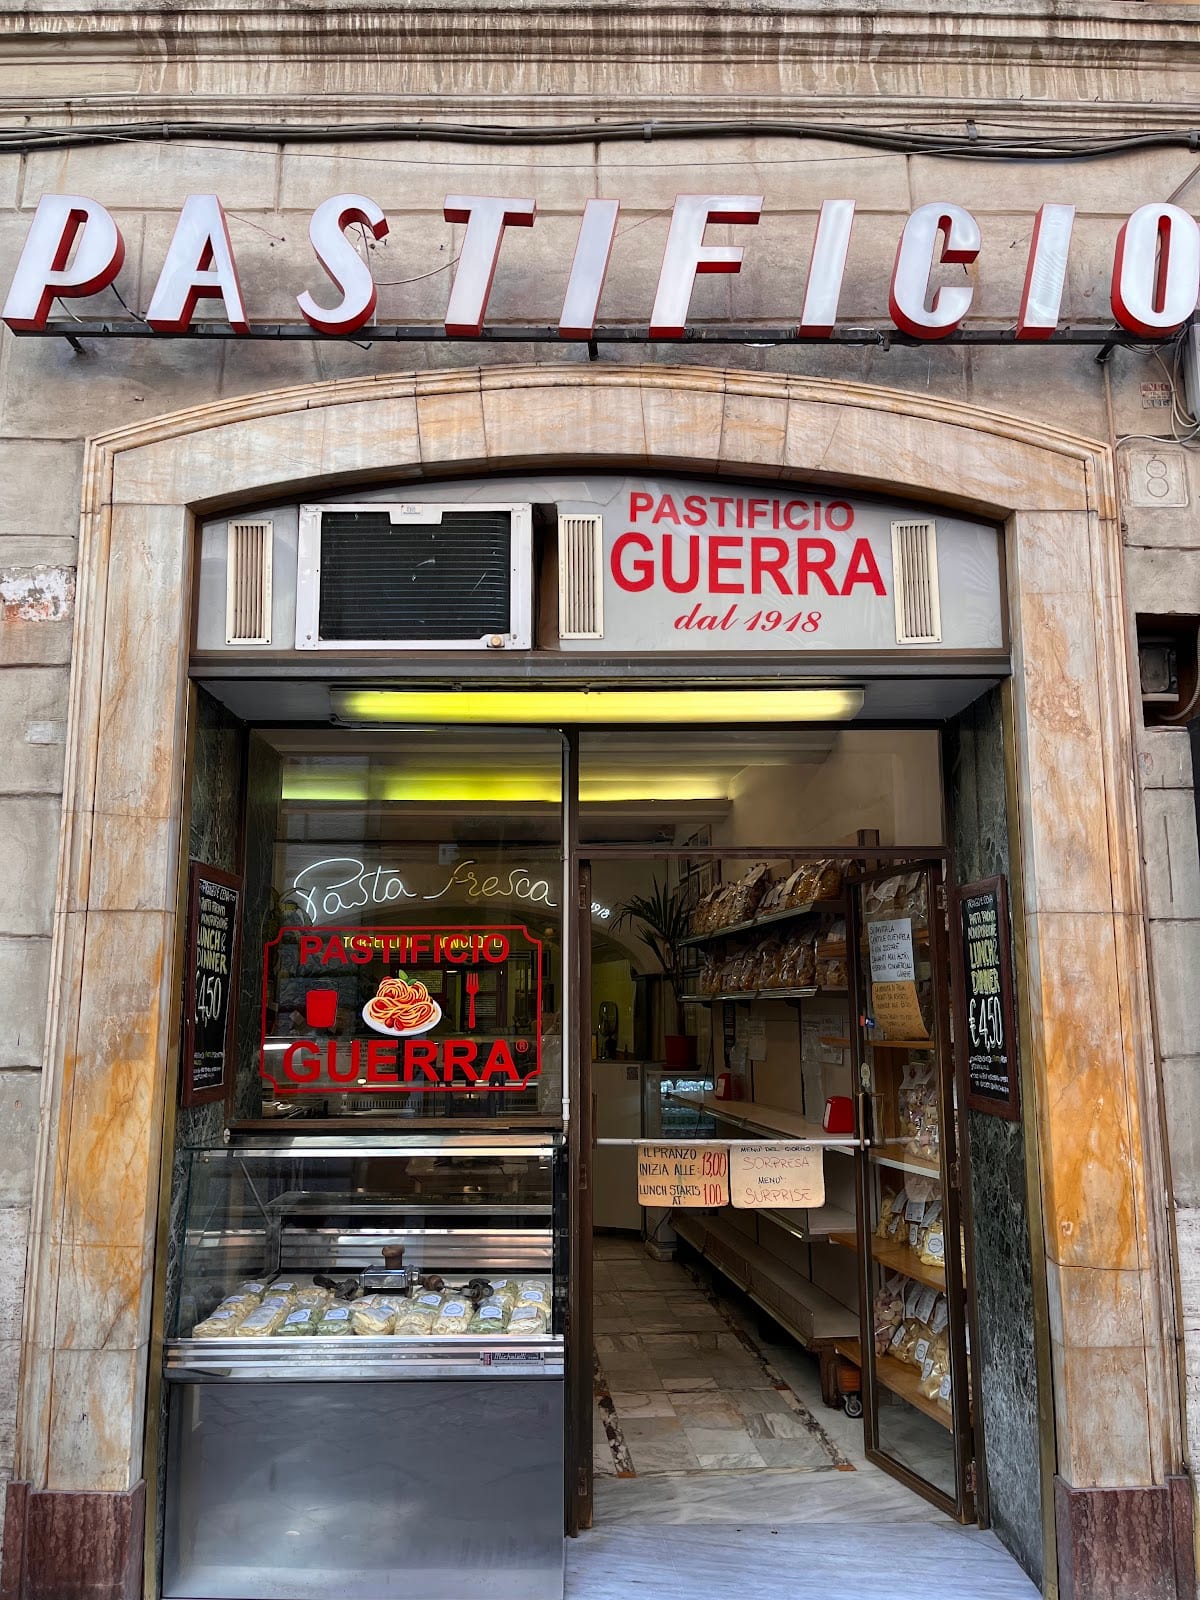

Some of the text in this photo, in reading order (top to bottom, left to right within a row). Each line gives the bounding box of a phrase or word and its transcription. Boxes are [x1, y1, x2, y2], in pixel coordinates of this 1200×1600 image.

[2, 193, 1200, 343] PASTIFICIO
[1146, 459, 1169, 498] 8
[629, 491, 855, 532] PASTIFICIO
[610, 531, 887, 597] GUERRA
[674, 603, 823, 634] dal 1918
[293, 858, 558, 925] Pasta Fresca
[197, 923, 220, 951] LUNCH
[299, 934, 510, 966] PASTIFICIO
[197, 946, 227, 975] DINNER
[969, 939, 995, 969] LUNCH
[971, 968, 1000, 995] DINNER
[282, 1039, 520, 1083] GUERRA
[653, 1147, 697, 1161] PRANZO
[742, 1156, 810, 1171] SORPRESA
[639, 1163, 669, 1176] INIZIA
[639, 1184, 667, 1196] LUNCH
[669, 1184, 701, 1197] STARTS
[743, 1187, 813, 1205] SURPRISE
